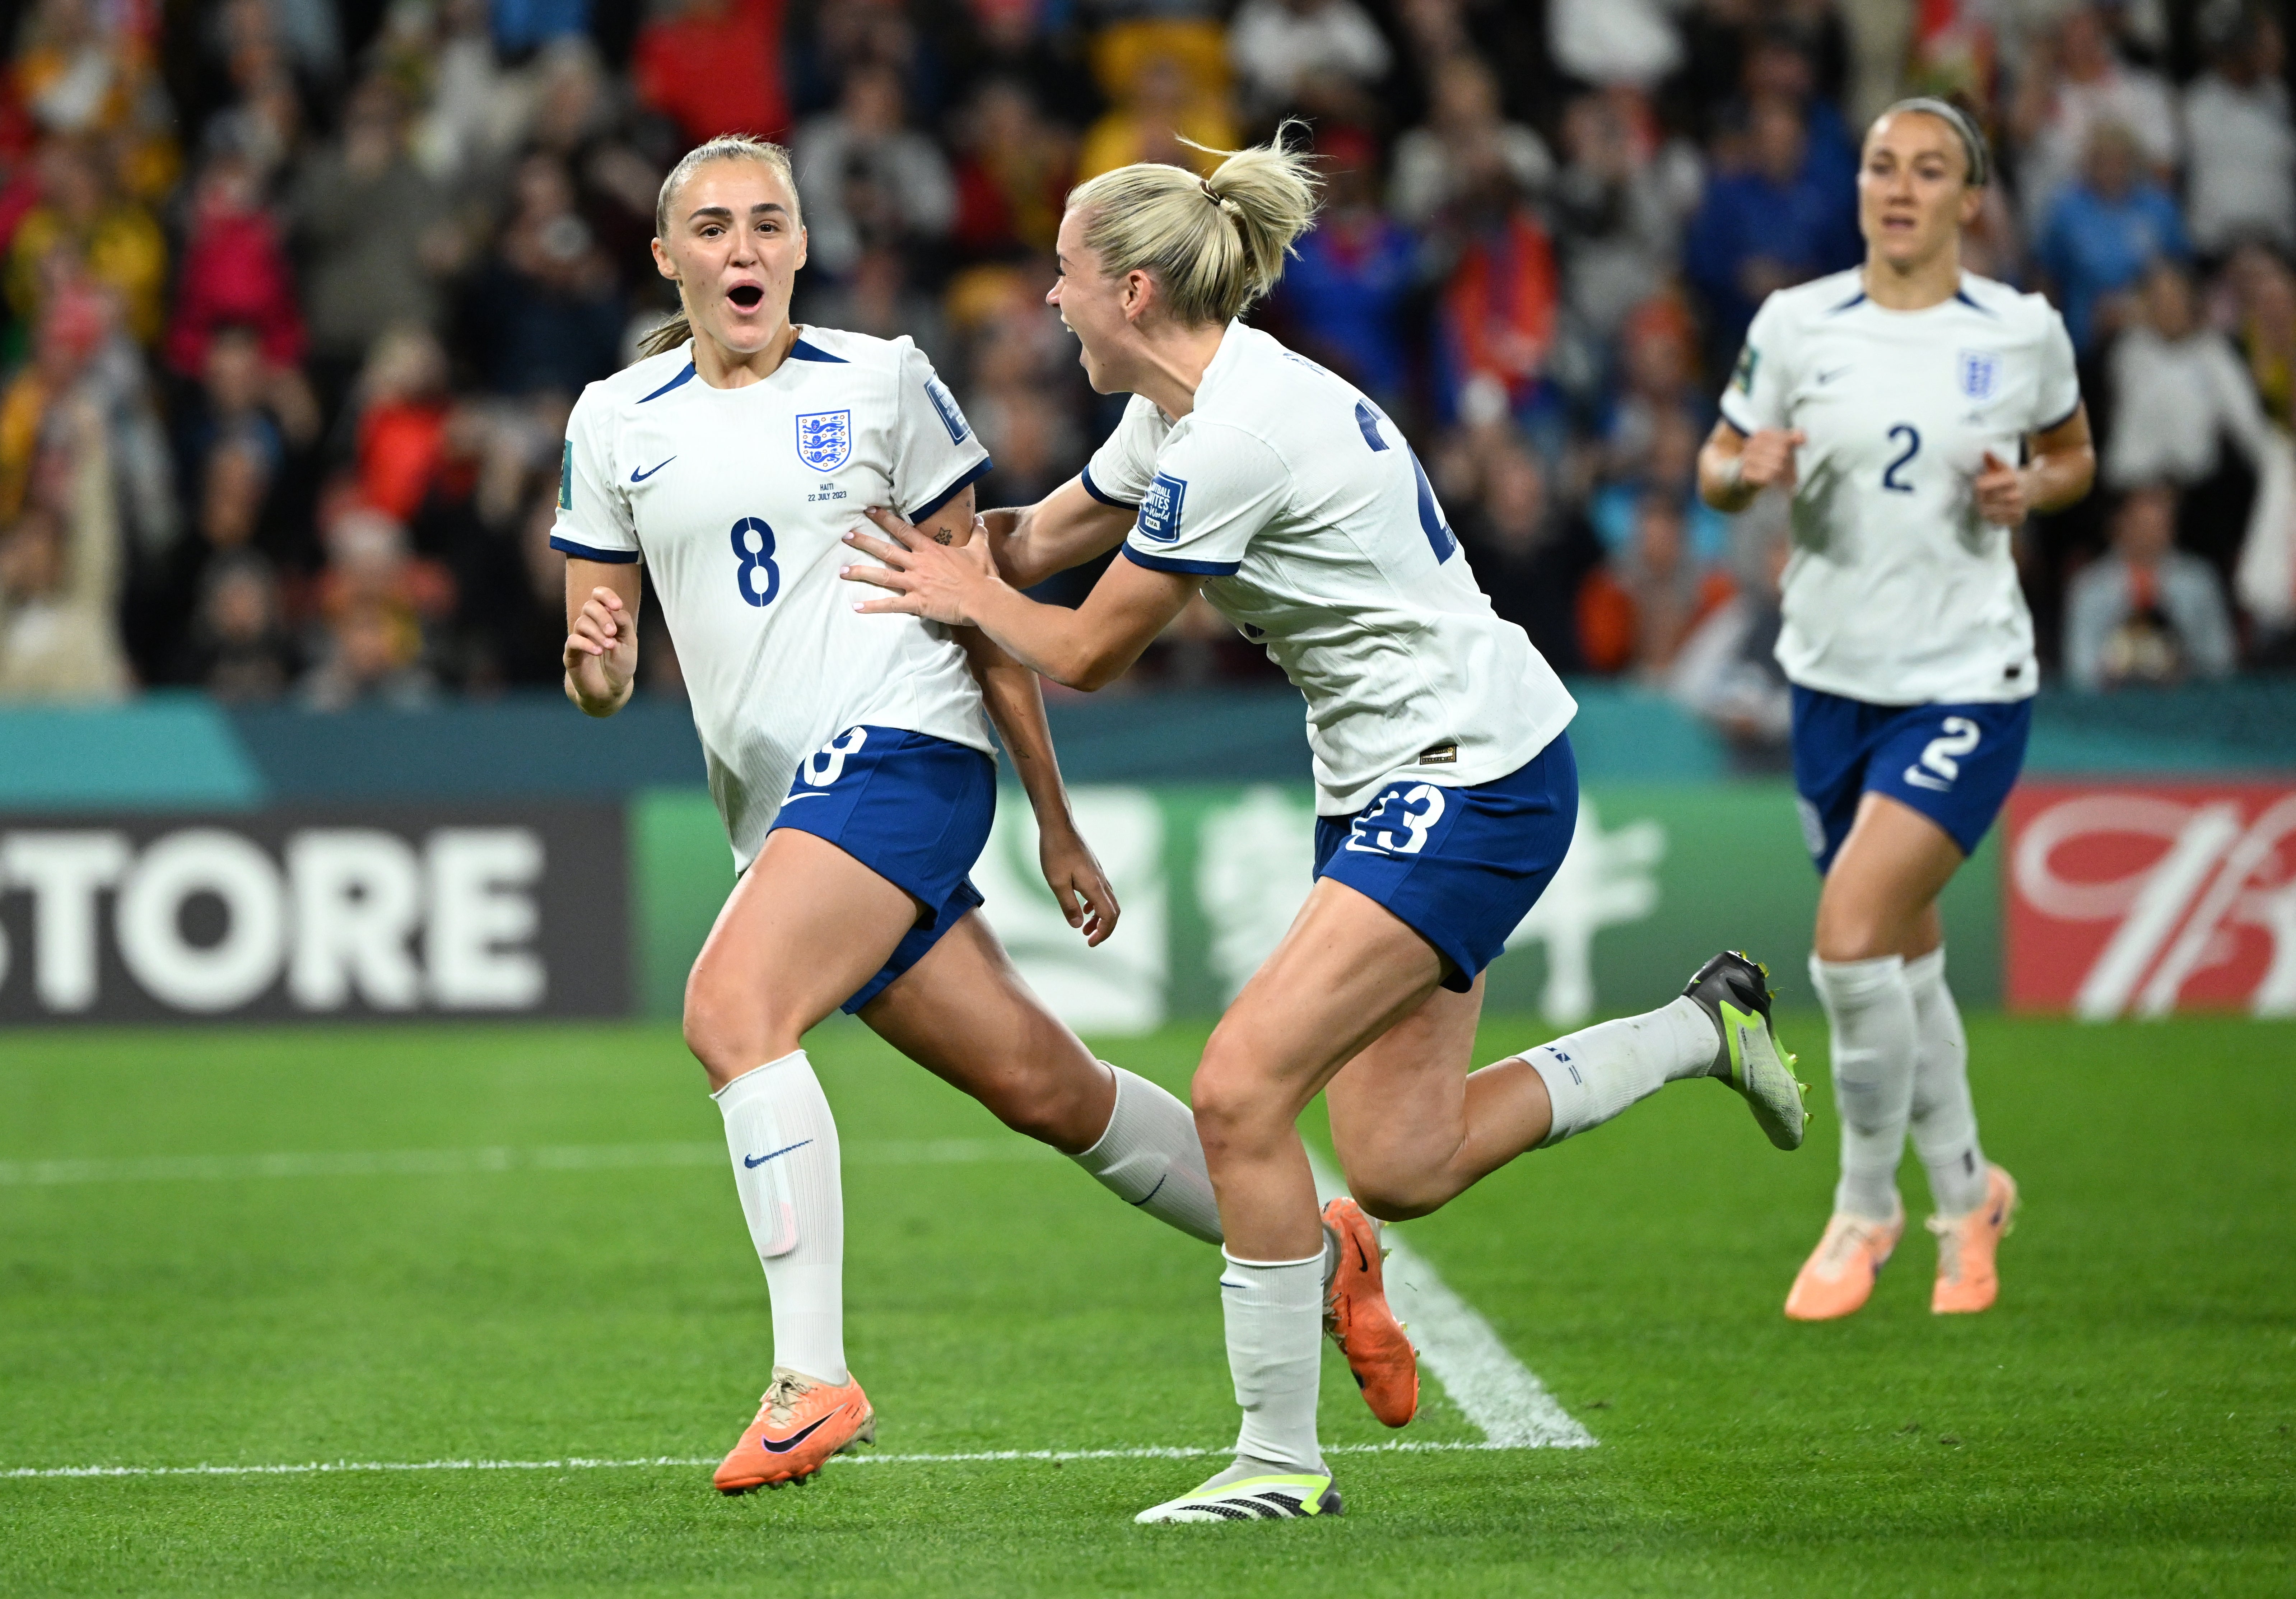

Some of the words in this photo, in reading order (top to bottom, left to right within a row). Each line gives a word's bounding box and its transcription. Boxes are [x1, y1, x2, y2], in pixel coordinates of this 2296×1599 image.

[1882, 425, 1920, 492] 2
[832, 491, 847, 499] 2023
[1147, 519, 1158, 527] FIFA
[1149, 505, 1170, 522] World
[731, 517, 779, 607] 8
[804, 726, 867, 787] 8
[1920, 716, 1981, 782] 2
[0, 826, 547, 1013] TORE
